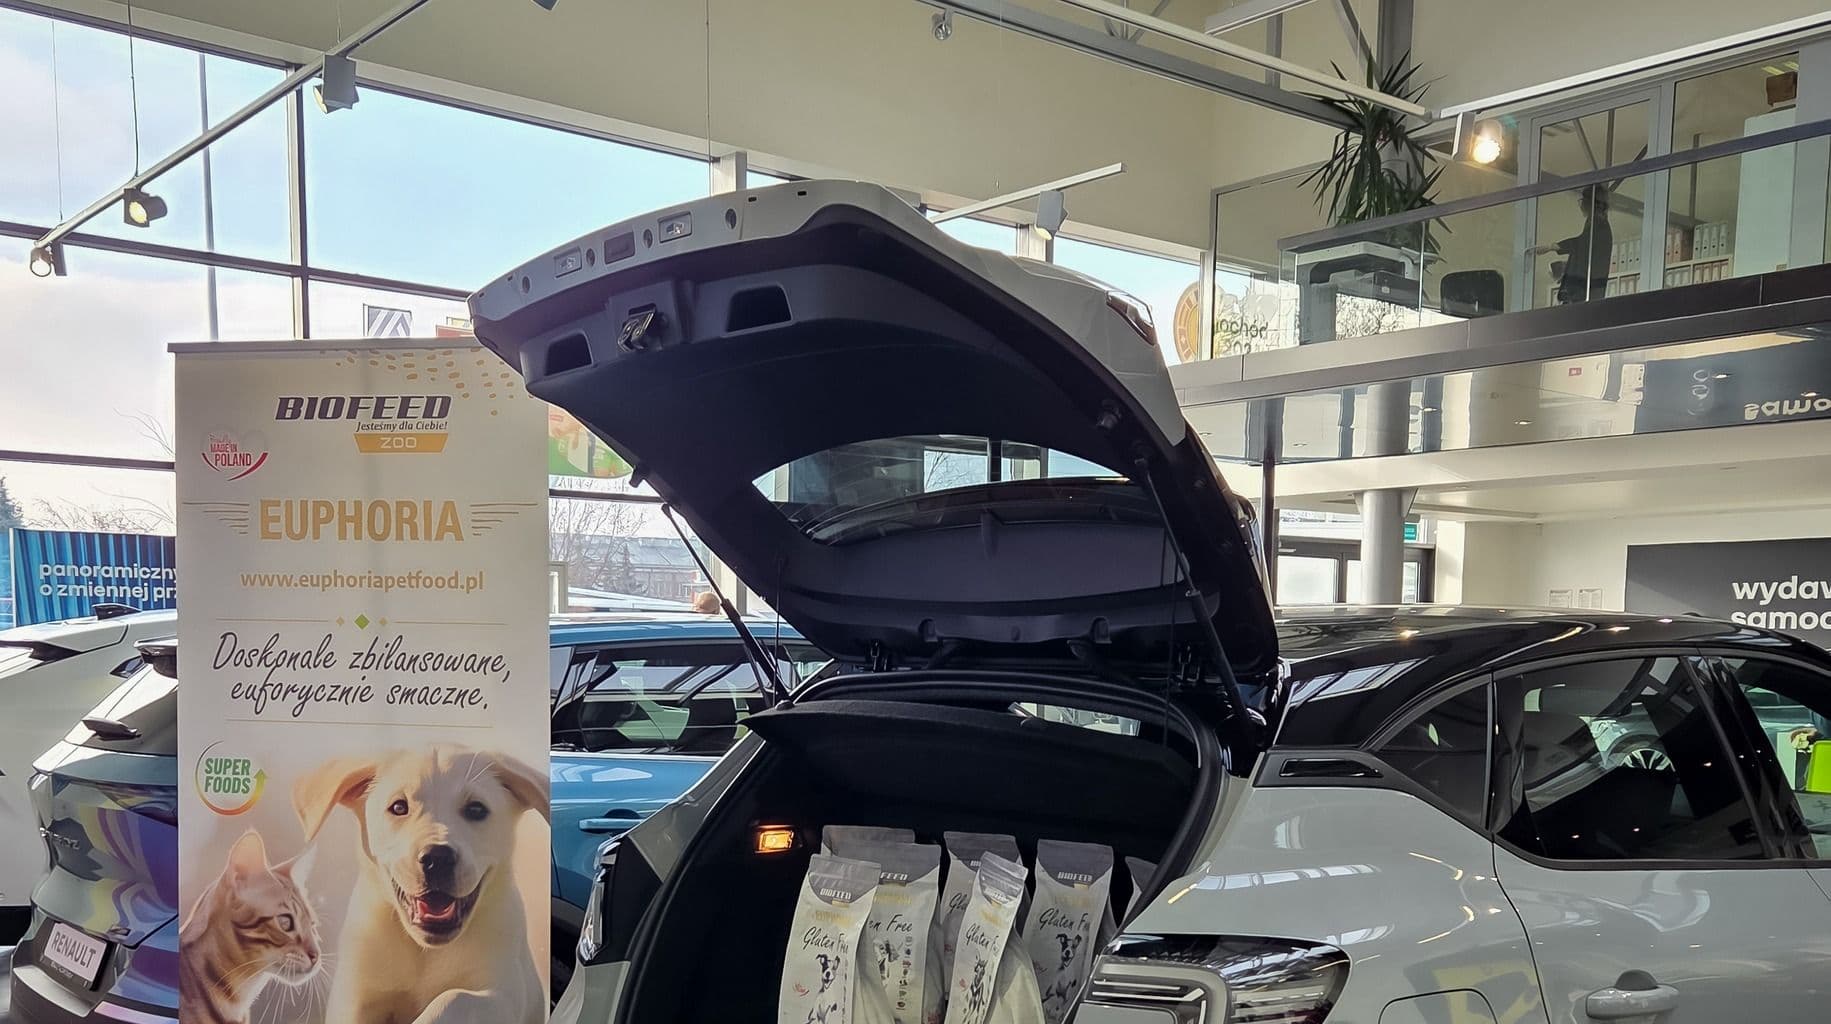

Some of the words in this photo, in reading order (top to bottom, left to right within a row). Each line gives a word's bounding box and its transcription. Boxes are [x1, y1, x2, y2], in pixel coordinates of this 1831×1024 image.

[275, 395, 452, 420] BIOFEED
[356, 421, 397, 432] Jesteśmy
[398, 421, 413, 431] dla
[415, 421, 448, 431] Ciebie!
[379, 436, 417, 449] ZOO
[214, 453, 252, 467] POLAND
[259, 499, 465, 542] EUPHORIA
[39, 584, 53, 596] o
[57, 581, 149, 602] zmiennej
[240, 569, 484, 593] www.euphoriapetfood.pl
[213, 632, 338, 670] Doskonale
[348, 634, 511, 683] zbilansowane,
[230, 665, 375, 717] euforycznie
[386, 683, 489, 710] smaczne.
[204, 757, 251, 775] SUPER
[204, 776, 251, 794] FOODS
[886, 914, 913, 932] Free
[1040, 908, 1075, 931] Gluten
[803, 926, 835, 950] Gluten
[51, 932, 97, 969] RENAULT
